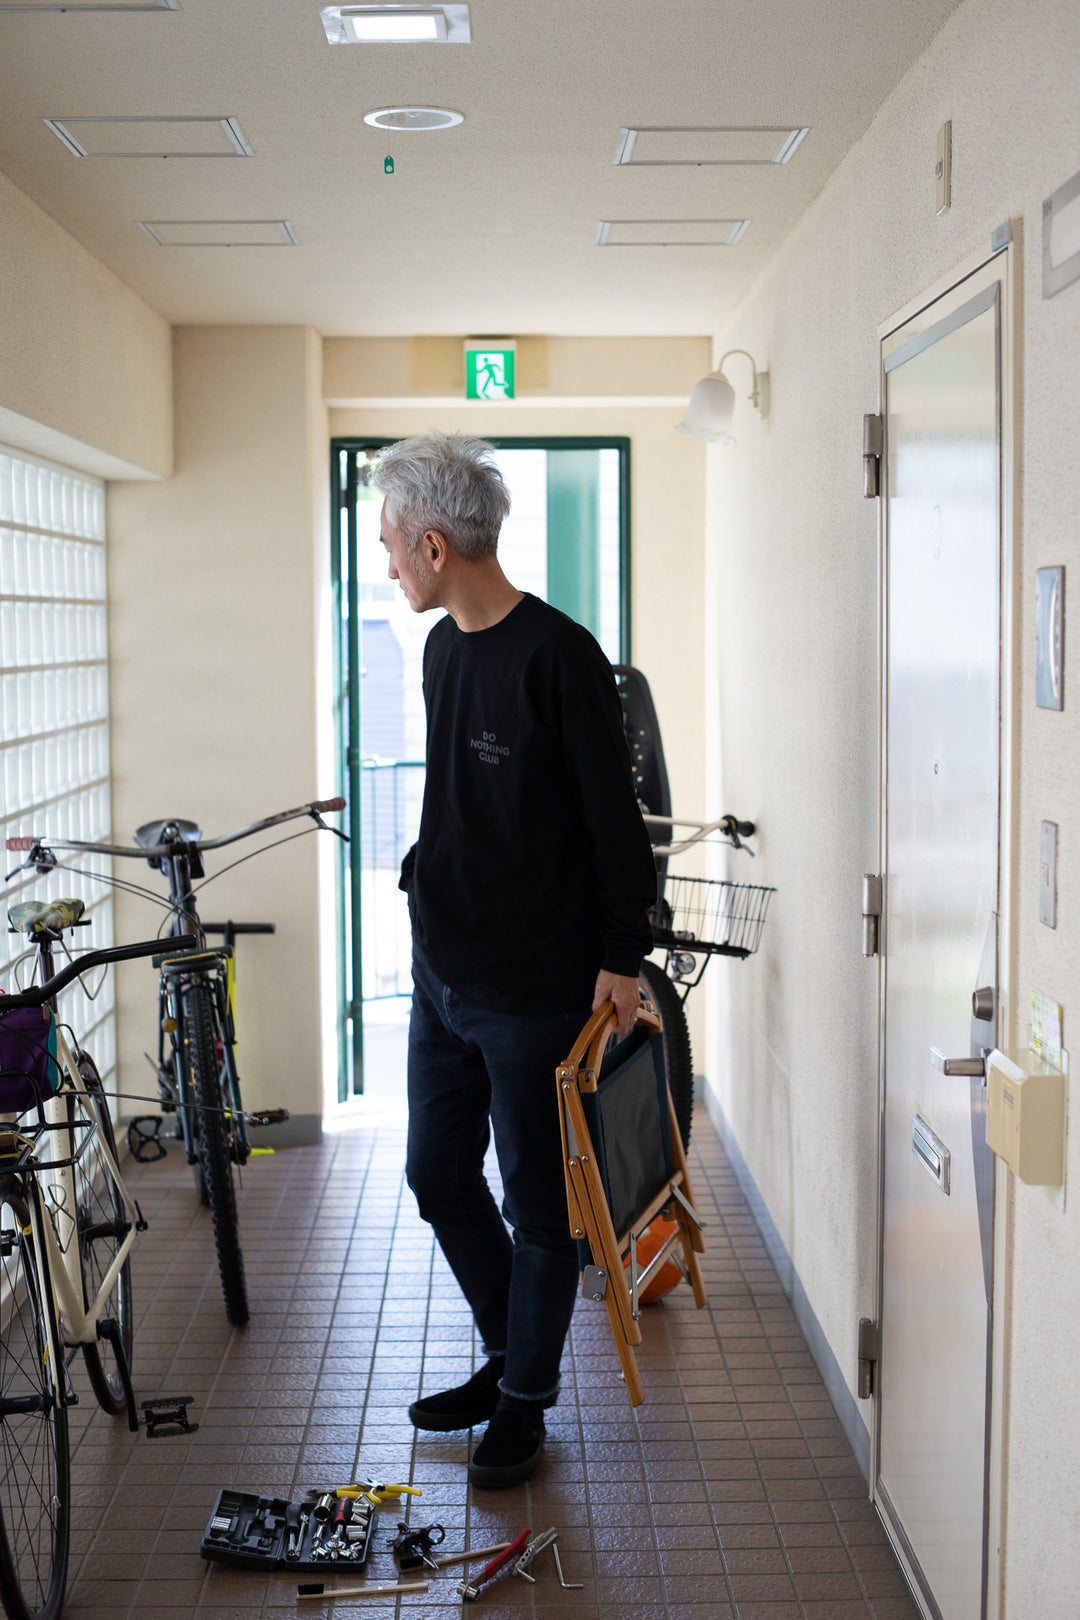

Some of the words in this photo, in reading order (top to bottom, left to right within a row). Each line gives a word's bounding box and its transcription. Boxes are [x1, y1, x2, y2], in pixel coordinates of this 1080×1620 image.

[483, 731, 496, 742] DO
[470, 738, 510, 756] NOTHING
[479, 751, 500, 765] CLUB
